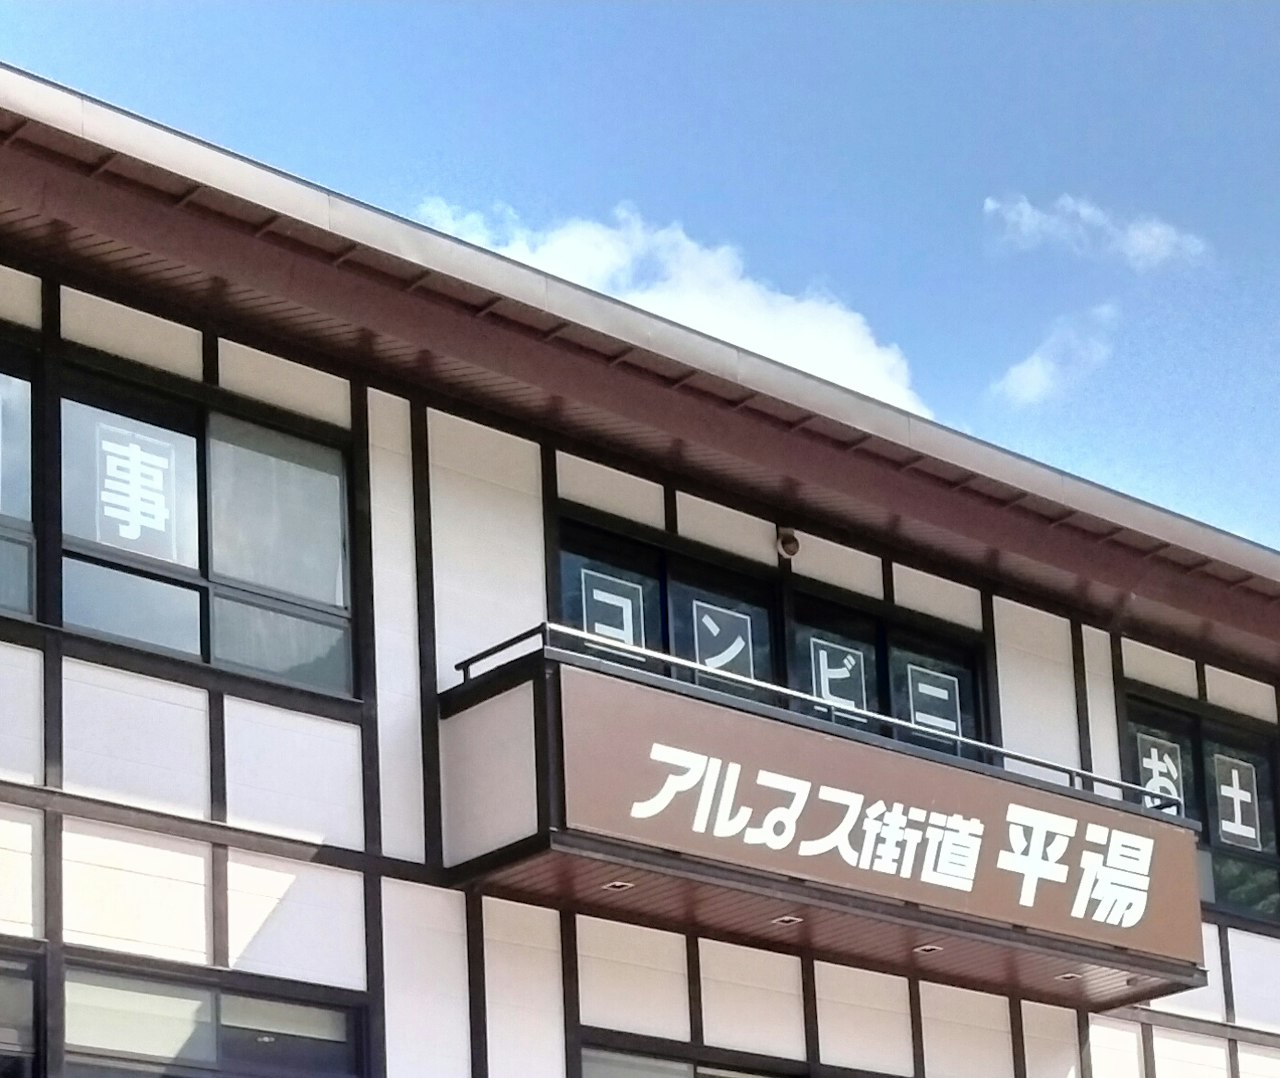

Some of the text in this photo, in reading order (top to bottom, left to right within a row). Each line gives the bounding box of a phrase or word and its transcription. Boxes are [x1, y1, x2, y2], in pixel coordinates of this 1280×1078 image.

[630, 742, 1155, 929] アルプス街道 平湯
